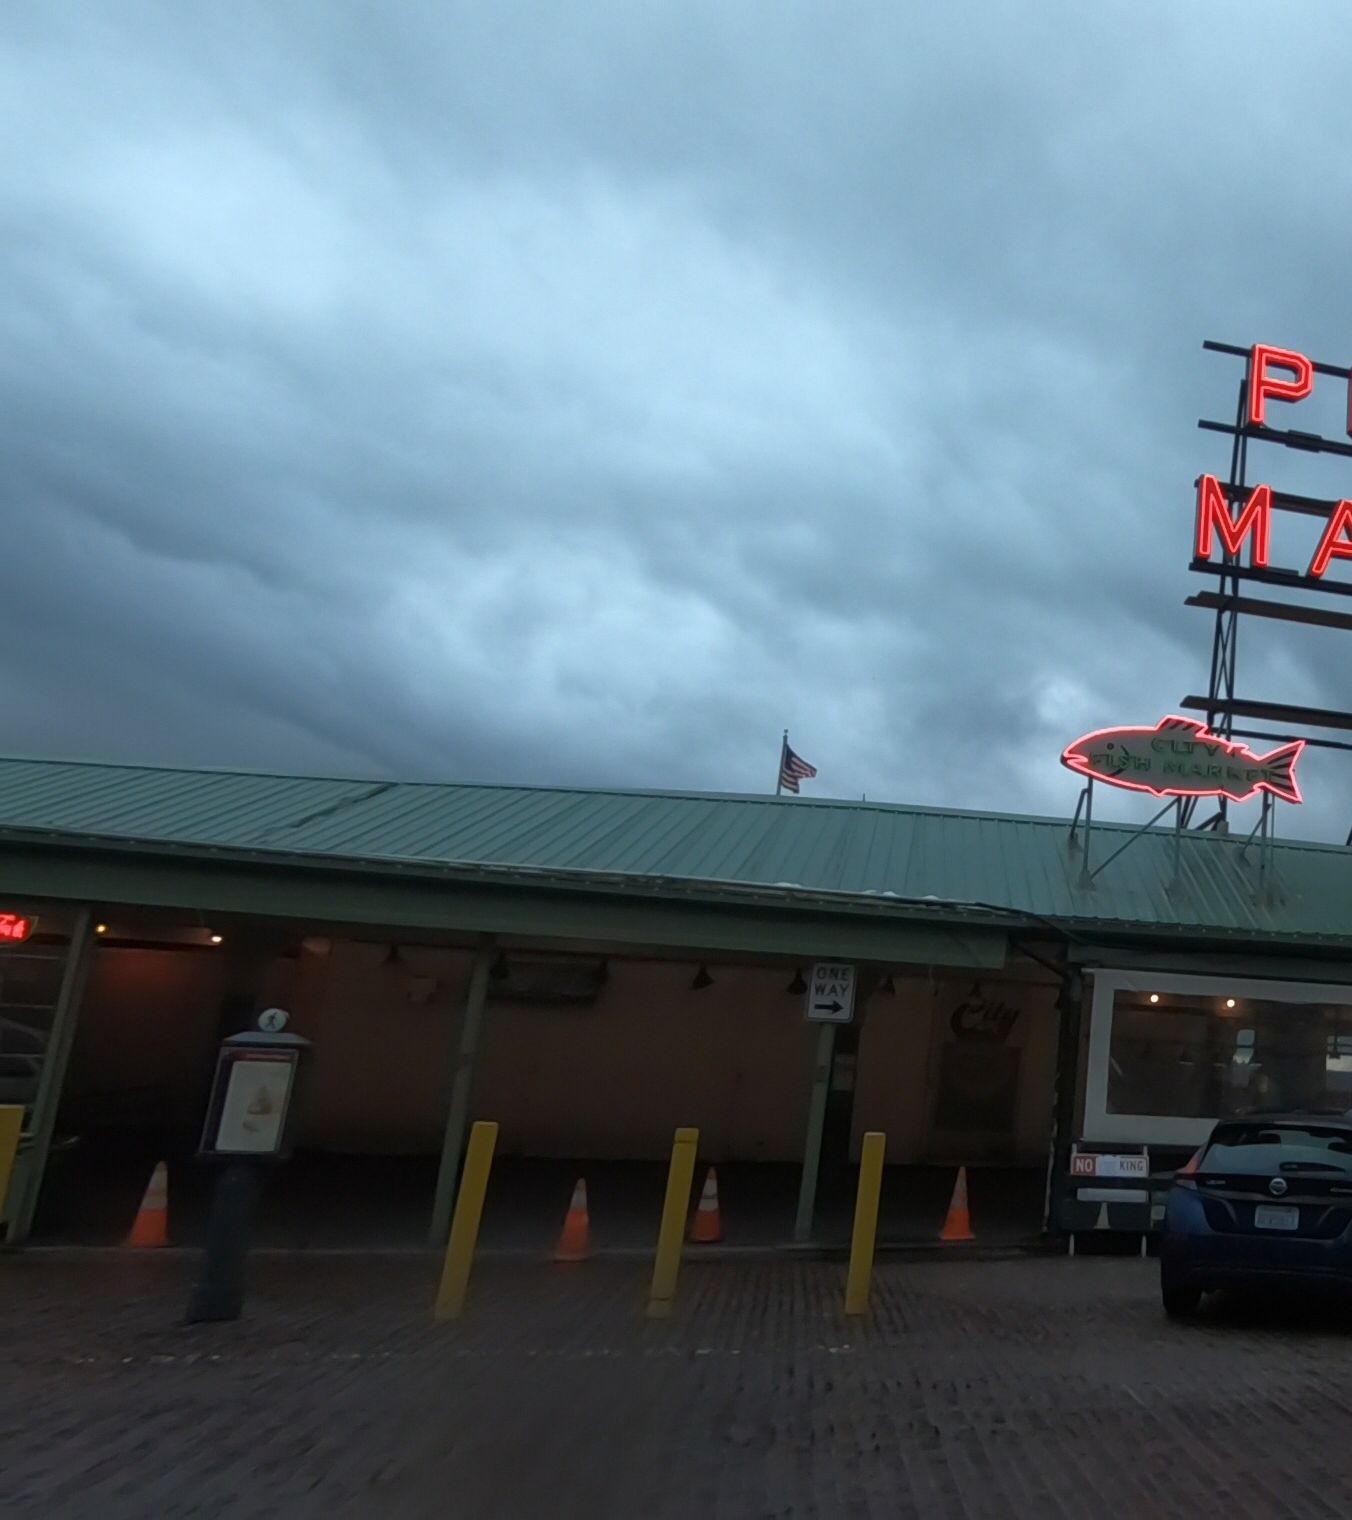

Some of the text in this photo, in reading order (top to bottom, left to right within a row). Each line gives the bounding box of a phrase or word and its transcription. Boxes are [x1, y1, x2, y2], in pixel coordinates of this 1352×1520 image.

[1150, 737, 1220, 758] CITY
[1089, 752, 1273, 783] FISH MARKET
[816, 966, 849, 982] ONE
[814, 983, 849, 997] WAY
[950, 1001, 1020, 1040] City
[1075, 1158, 1094, 1173] NO
